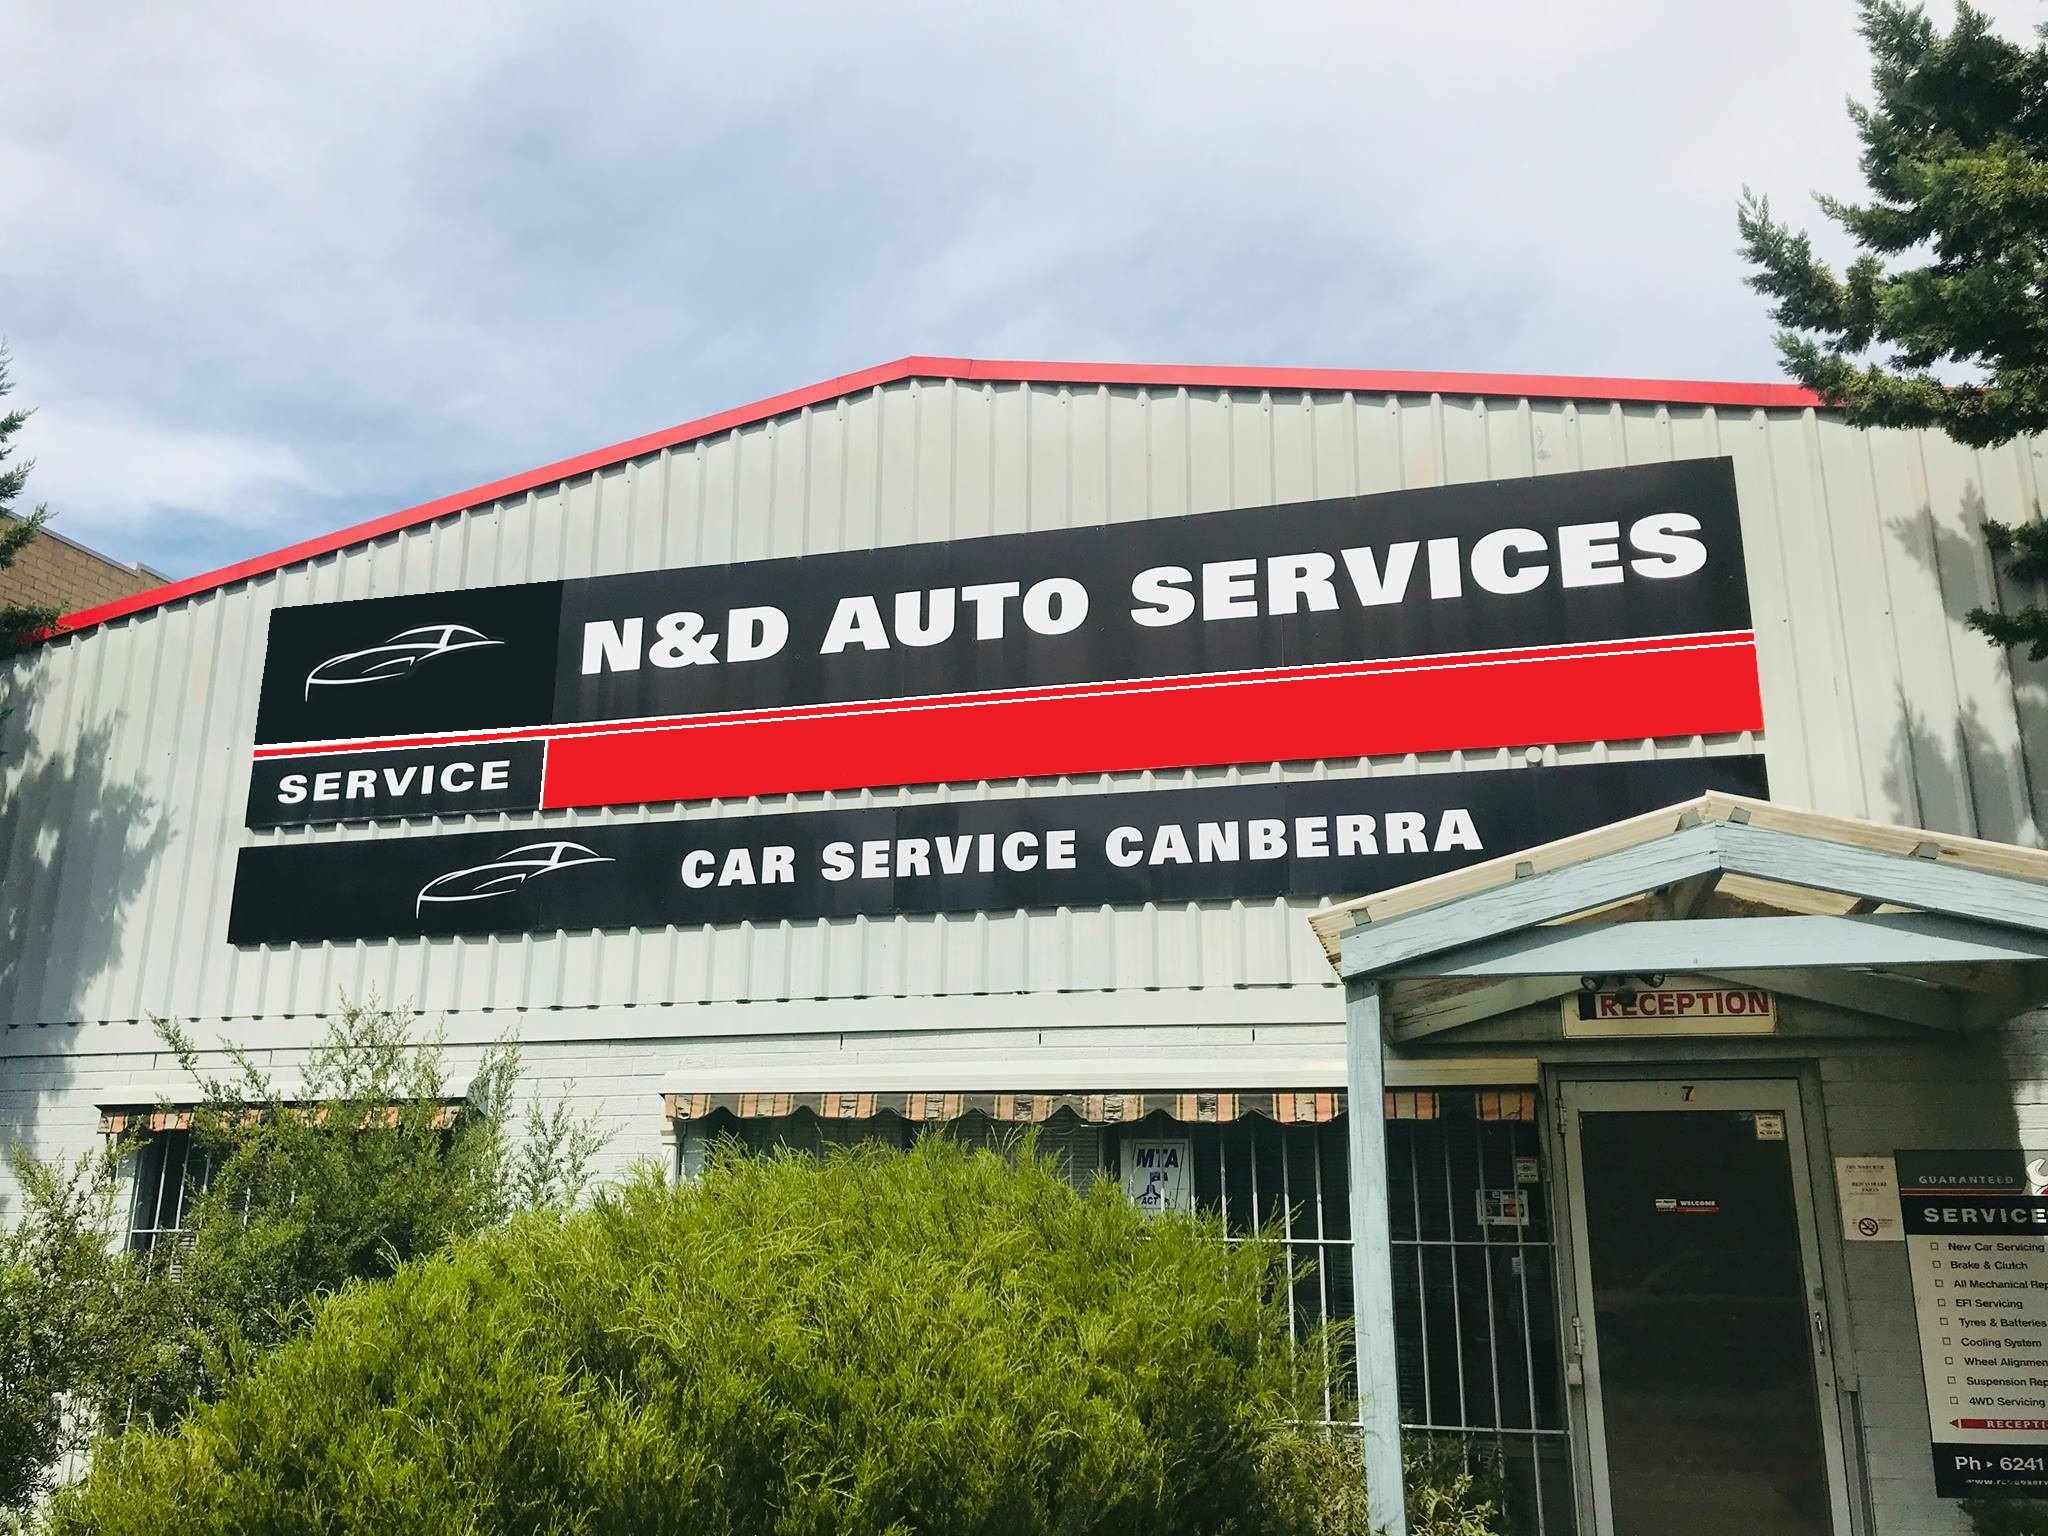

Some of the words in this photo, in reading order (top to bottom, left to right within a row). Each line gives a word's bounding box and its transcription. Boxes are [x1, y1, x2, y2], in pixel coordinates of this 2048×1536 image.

[581, 606, 789, 675] N&D
[819, 577, 1090, 654] AUTO
[1130, 512, 1708, 627] SERVICES
[277, 760, 511, 804] SERVICE
[681, 845, 796, 889] CAR
[821, 829, 1077, 881] SERVICE
[1105, 808, 1484, 868] CANBERRA
[1681, 1085, 1695, 1101] 7
[1136, 1148, 1179, 1168] MTA
[1918, 1175, 2014, 1185] GUARANTEED
[1141, 1196, 1159, 1205] ACT
[1923, 1207, 2048, 1223] SERVICE
[1947, 1242, 1971, 1251] New
[1974, 1242, 1993, 1251] Car
[1996, 1242, 2045, 1253] Servicing
[1950, 1261, 1980, 1270] Brake
[1983, 1261, 1991, 1270] &
[1994, 1261, 2028, 1270] Clutch
[1953, 1280, 1967, 1289] All
[1969, 1280, 2029, 1289] Mechanical
[1955, 1299, 1972, 1308] EFI
[1975, 1299, 2024, 1310] Servicing
[1958, 1317, 1987, 1328] Tyres
[1989, 1318, 1998, 1328] &
[2000, 1318, 2048, 1328] Batteries
[1961, 1337, 2002, 1348] Cooling
[2004, 1338, 2043, 1348] System
[1963, 1357, 1998, 1366] Wheel
[2000, 1357, 2048, 1368] Alignmen
[1966, 1376, 2027, 1388] Suspension
[1968, 1396, 1994, 1406] 4WD
[1997, 1396, 2046, 1408] Servicing
[1986, 1420, 2048, 1429] RECEPTI
[1955, 1455, 1981, 1470] Ph
[1999, 1456, 2044, 1471] 6241
